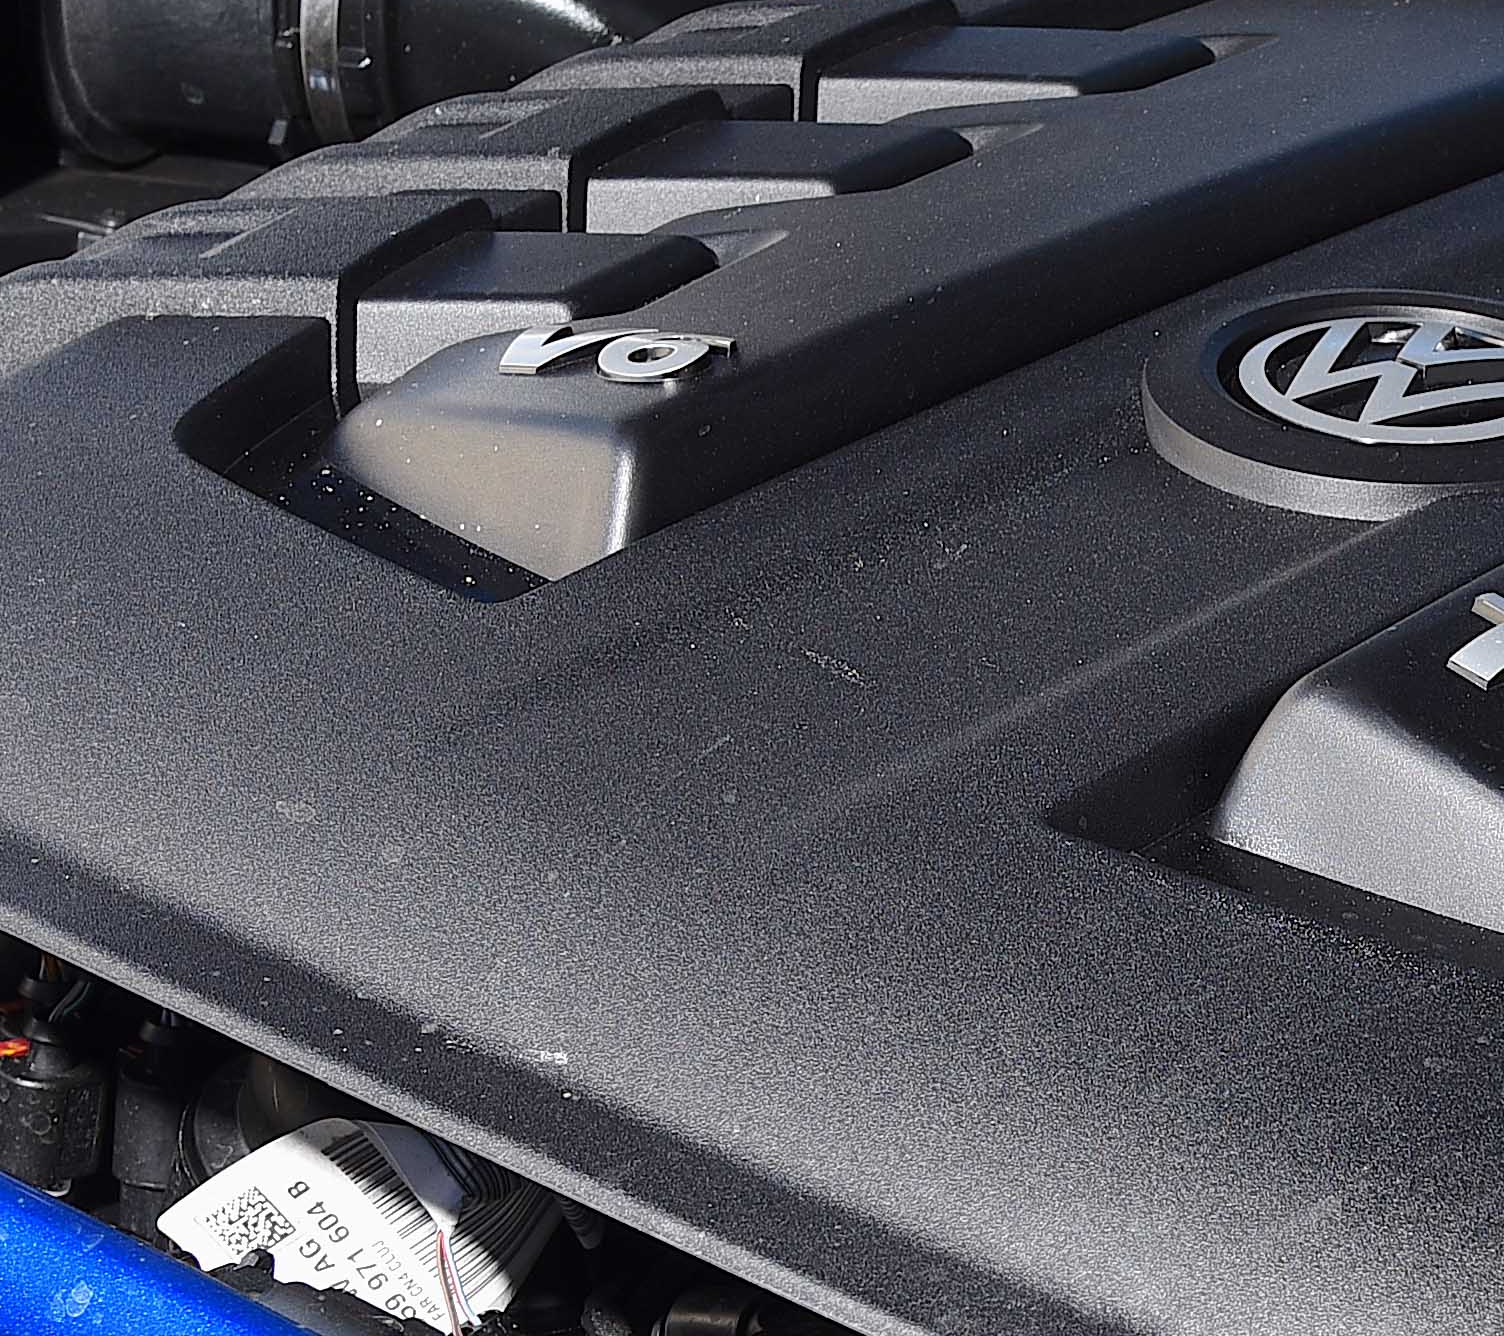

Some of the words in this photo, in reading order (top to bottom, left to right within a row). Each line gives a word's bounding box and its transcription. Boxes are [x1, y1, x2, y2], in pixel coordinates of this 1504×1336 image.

[498, 326, 737, 383] V6
[287, 1181, 310, 1199] B
[306, 1201, 350, 1243] 604
[299, 1238, 336, 1272] AG
[347, 1248, 389, 1290] 971
[419, 1296, 446, 1321] FAR
